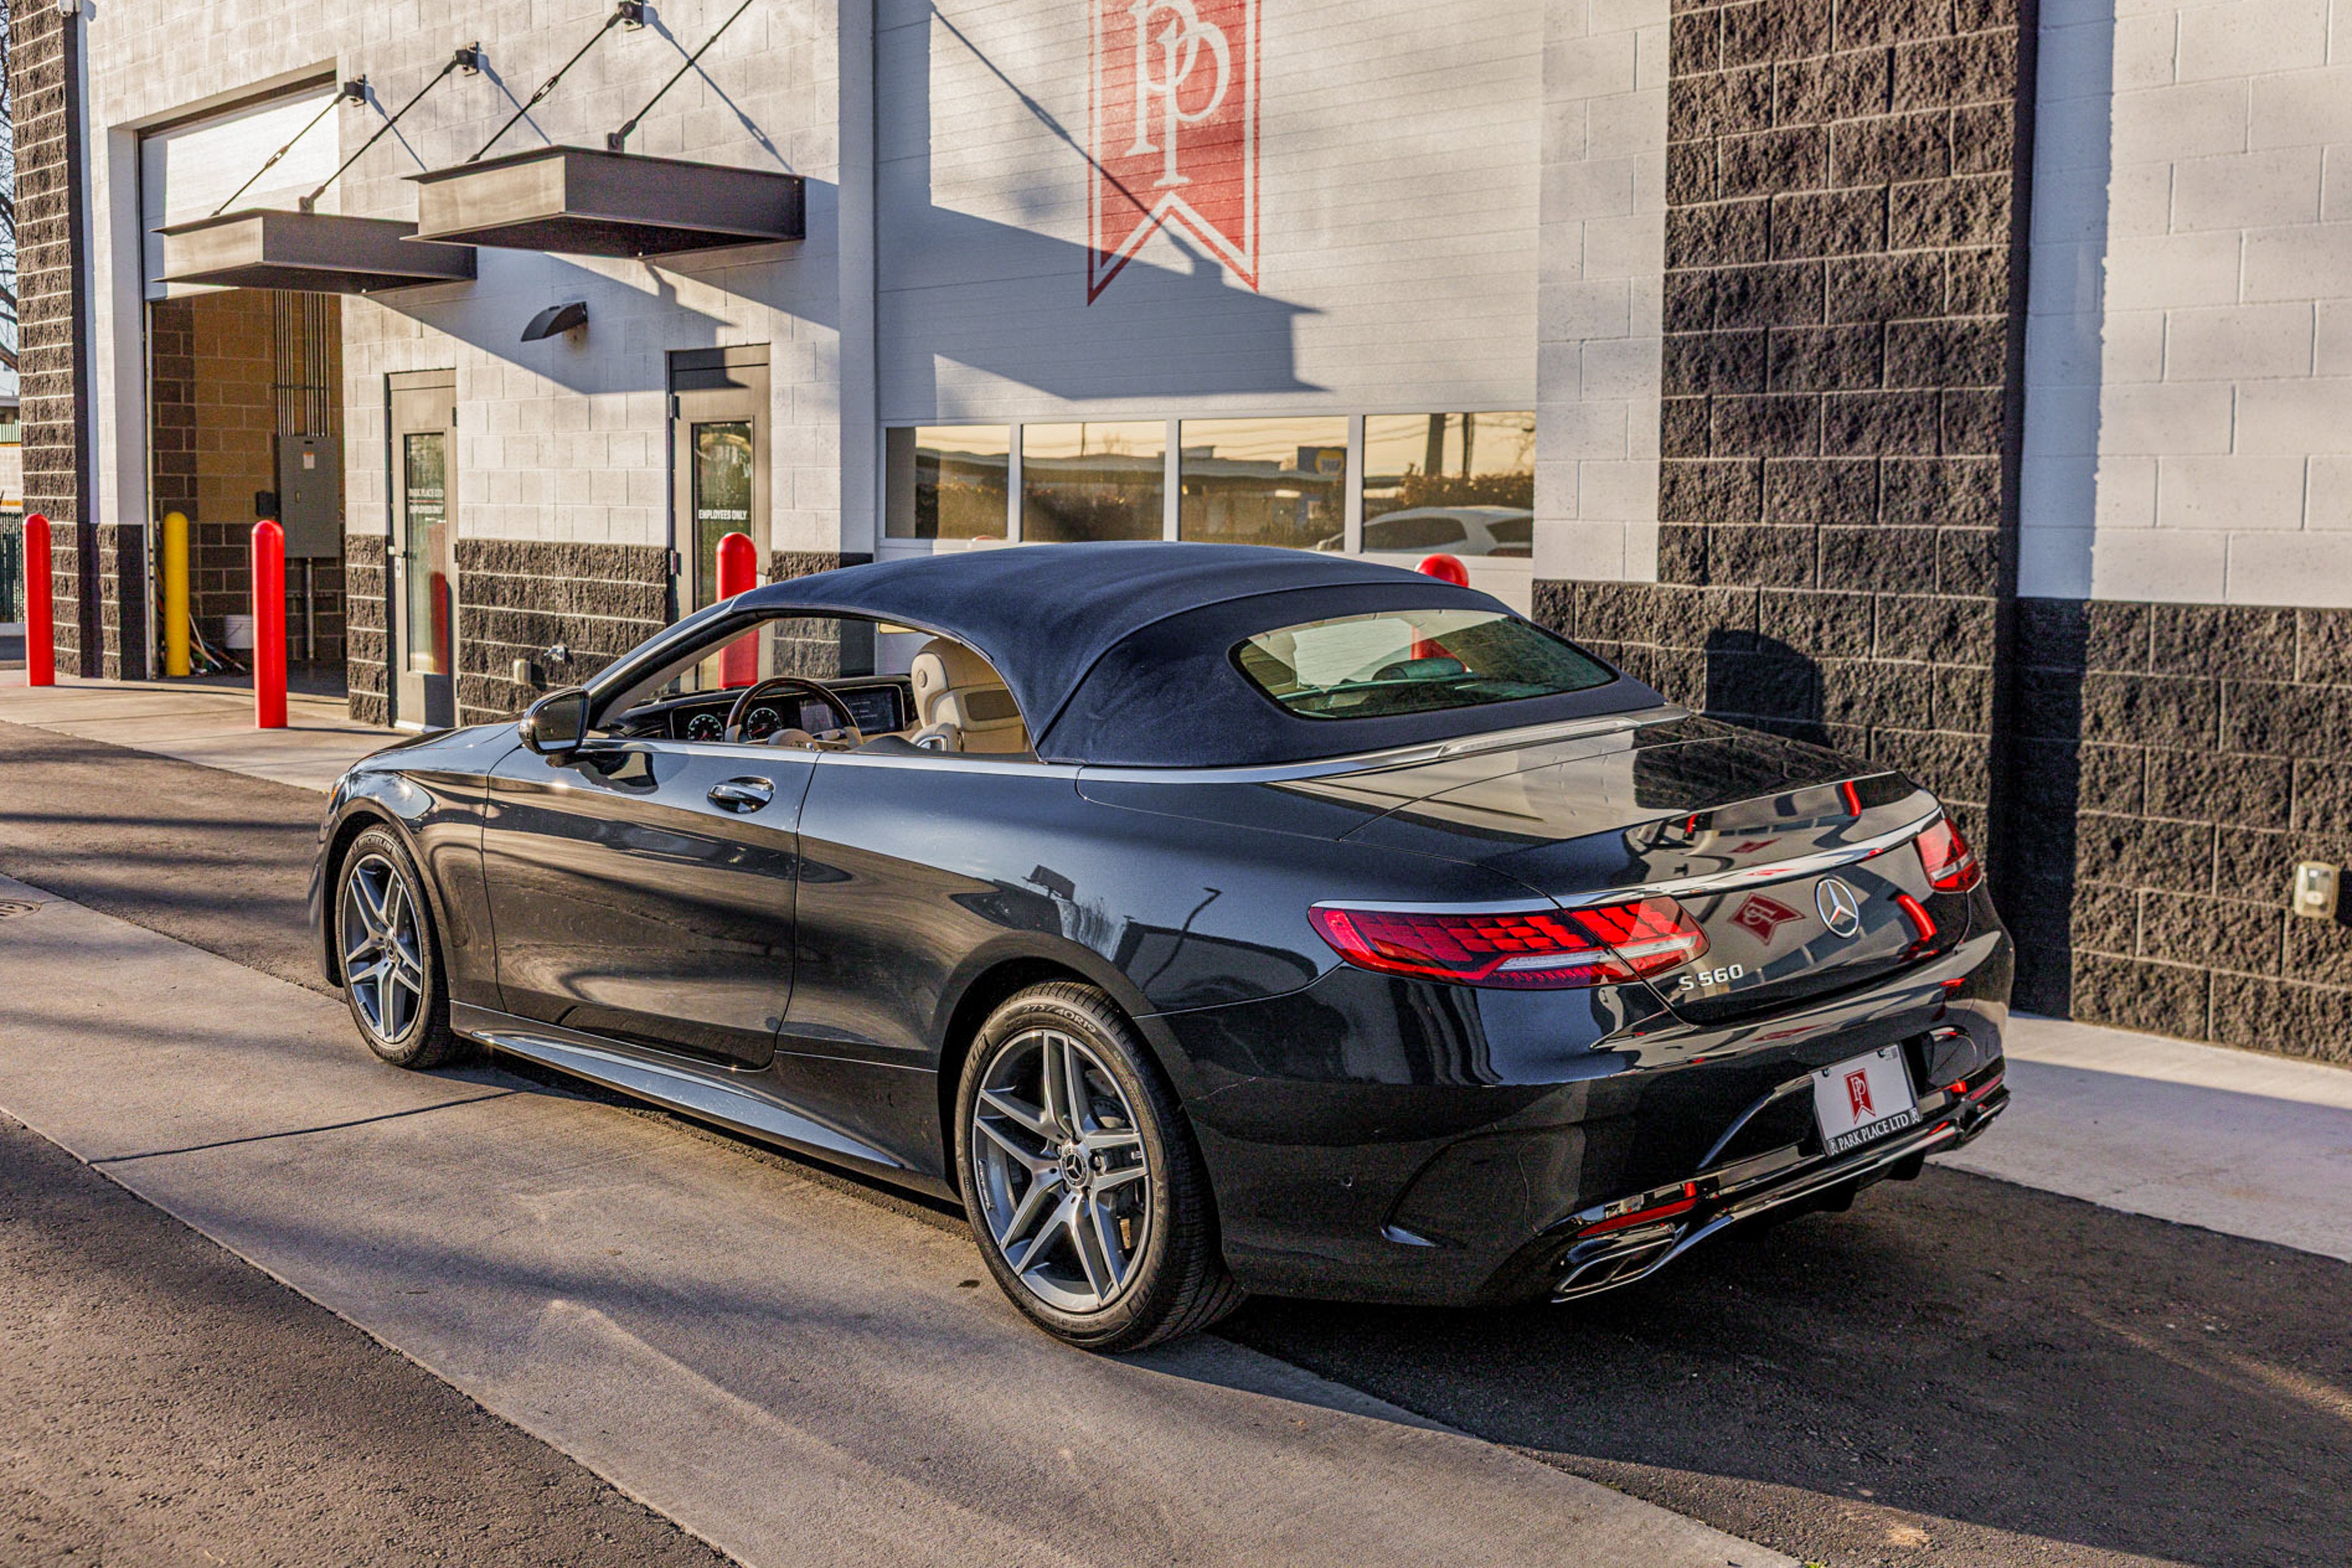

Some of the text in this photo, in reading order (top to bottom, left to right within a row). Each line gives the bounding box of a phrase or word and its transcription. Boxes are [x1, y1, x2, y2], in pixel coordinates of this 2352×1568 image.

[698, 509, 747, 520] EMPLOYEES ONLY
[1678, 964, 1744, 991] S 560
[1837, 1130, 1863, 1151] PARK
[1860, 1120, 1890, 1141] PLACE
[1889, 1113, 1908, 1131] LTD
